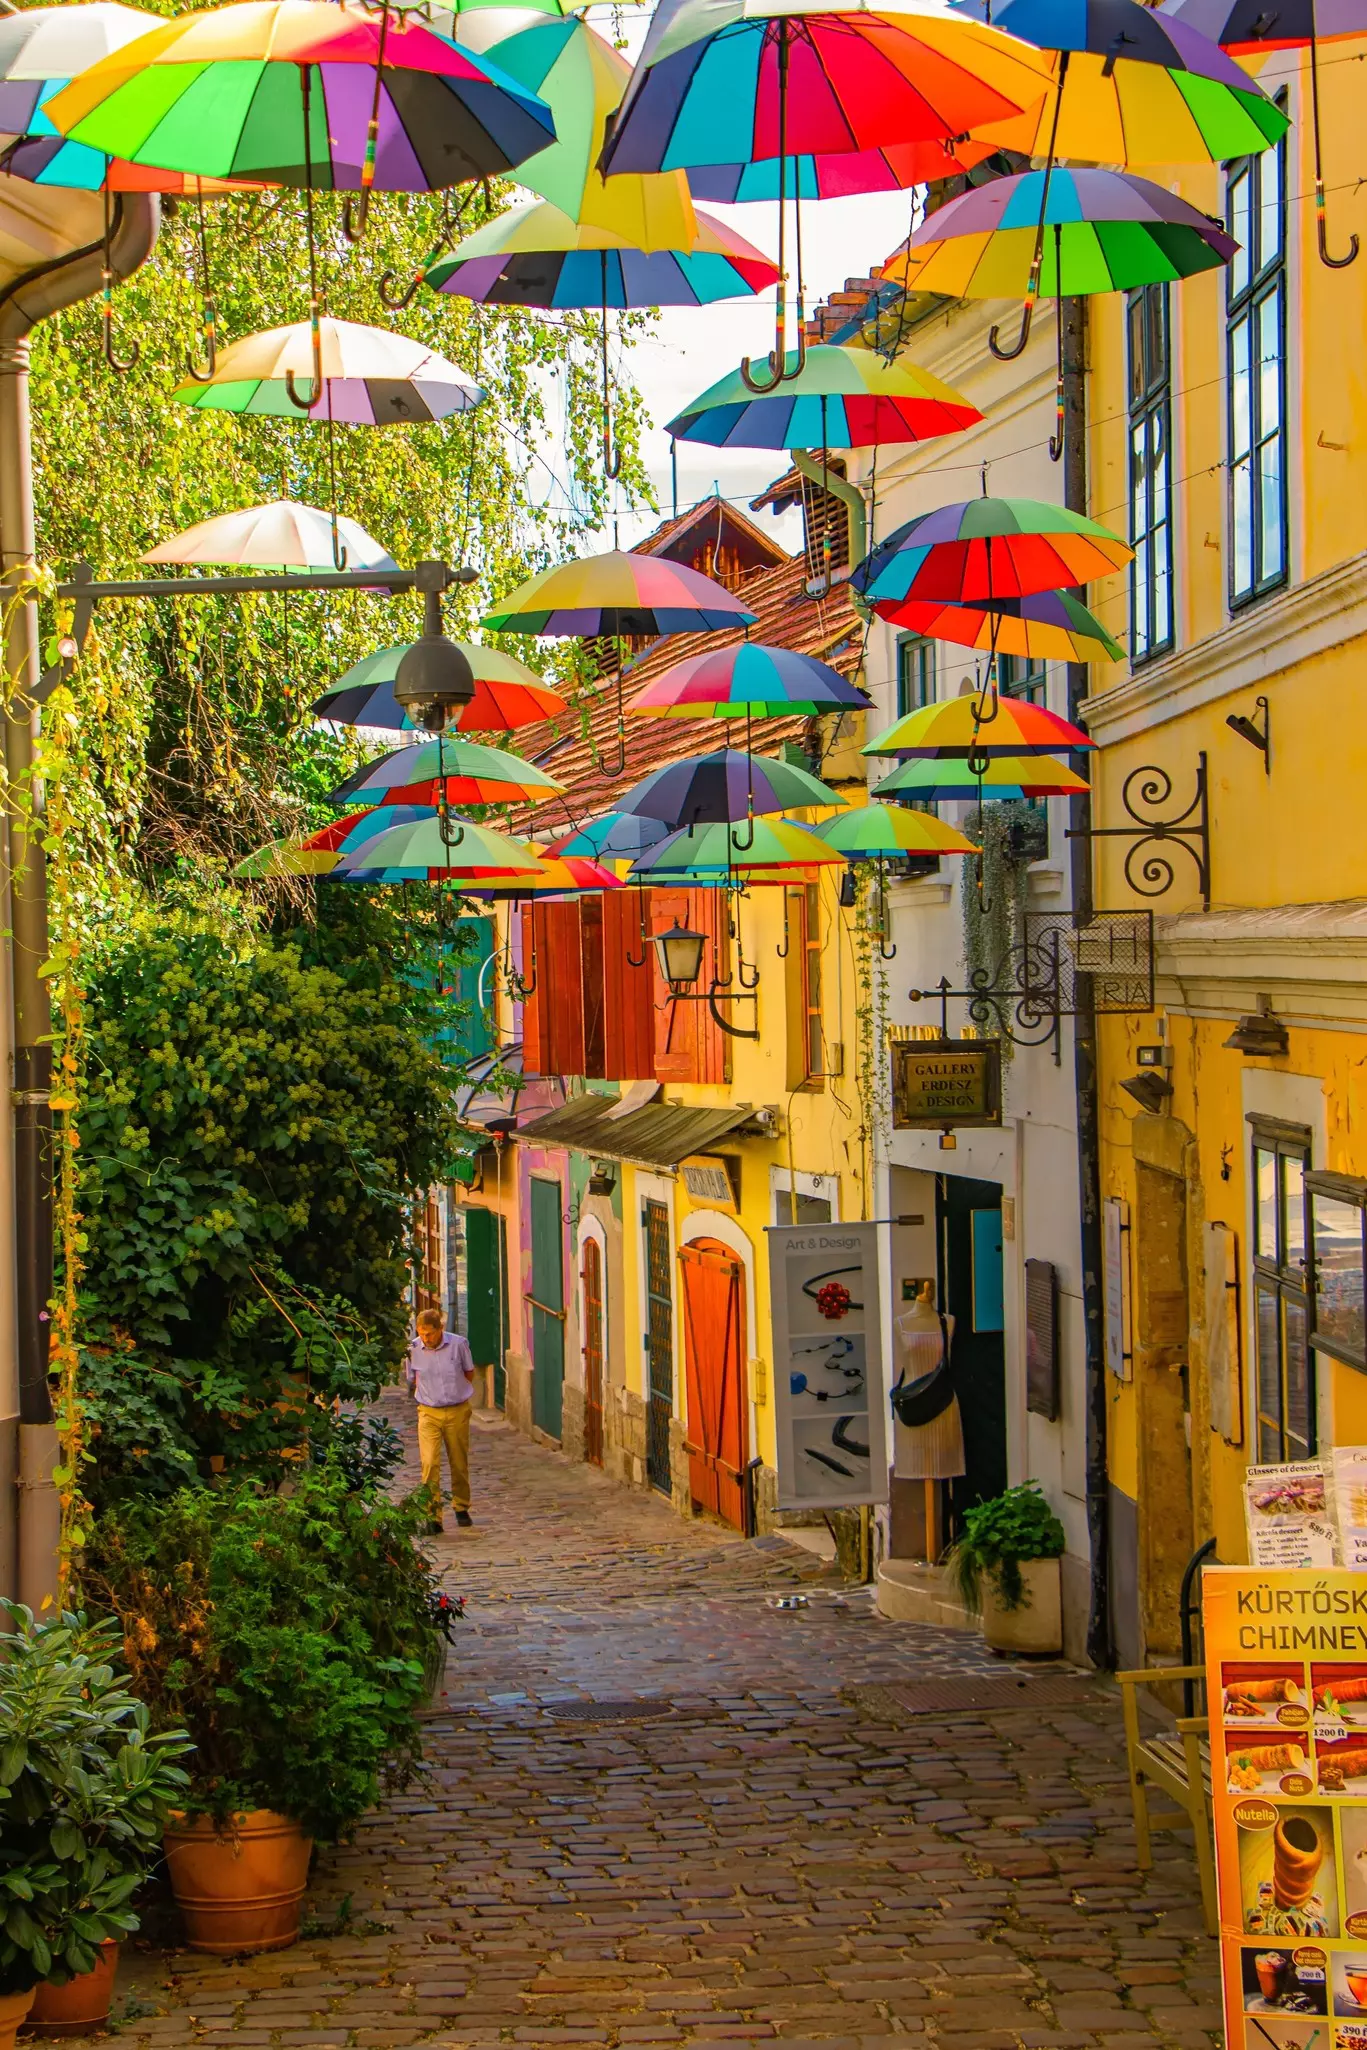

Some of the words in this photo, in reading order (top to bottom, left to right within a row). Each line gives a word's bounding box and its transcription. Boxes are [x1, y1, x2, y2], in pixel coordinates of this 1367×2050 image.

[1036, 924, 1137, 968] CEH
[915, 1064, 976, 1076] GALLERY
[927, 1095, 976, 1107] DESIGN
[786, 1239, 805, 1250] Art
[808, 1238, 816, 1249] &
[820, 1236, 861, 1249] Design
[1248, 1467, 1278, 1476] Glasses
[1290, 1463, 1320, 1472] dessert
[1237, 1581, 1367, 1614] KÜRTŐSK
[1239, 1625, 1367, 1650] CHIMNEY
[1314, 1729, 1335, 1737] 1200
[1337, 1728, 1345, 1736] ft
[1235, 1809, 1276, 1821] Nutella
[1342, 2025, 1361, 2036] 390
